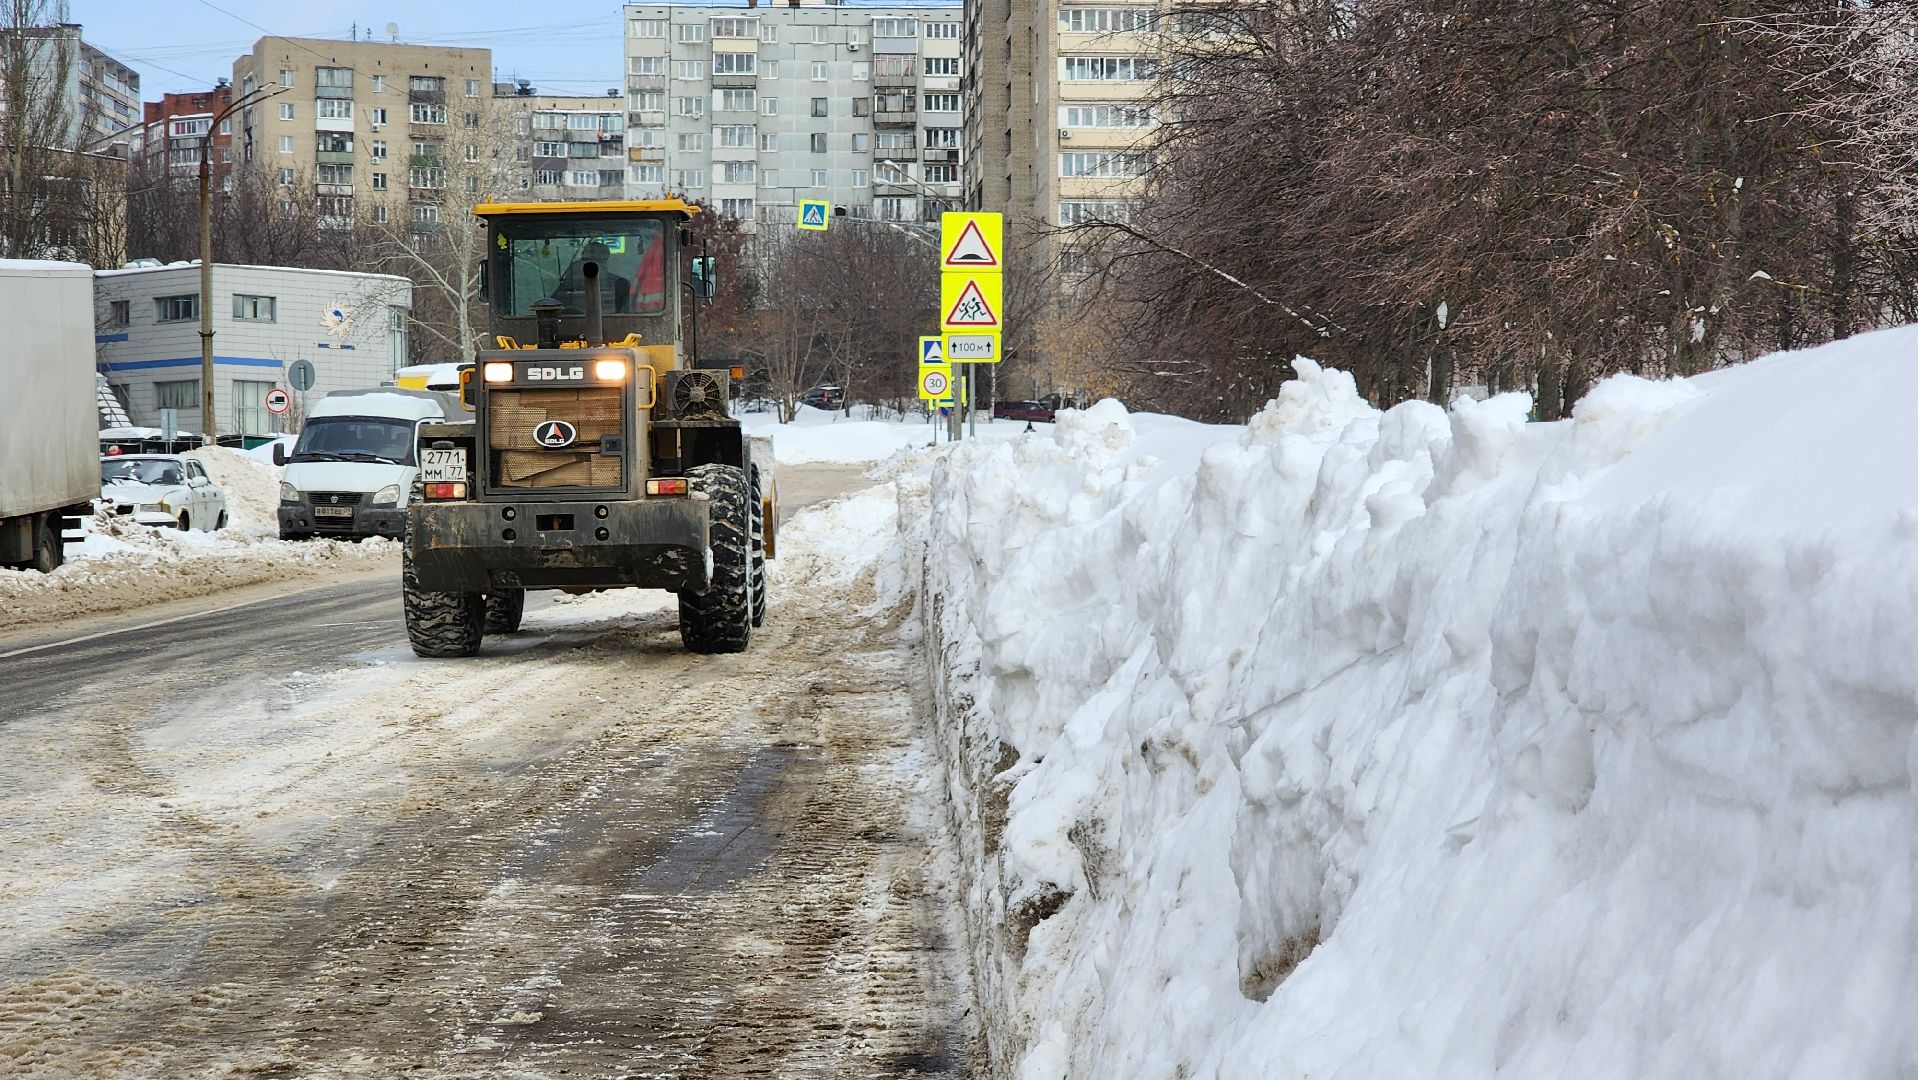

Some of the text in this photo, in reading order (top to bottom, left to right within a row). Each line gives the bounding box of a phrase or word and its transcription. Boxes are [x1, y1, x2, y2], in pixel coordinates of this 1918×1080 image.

[959, 342, 976, 352] 100
[527, 366, 584, 381] SDLG
[928, 378, 942, 388] 30
[427, 451, 461, 464] 2771
[449, 466, 463, 477] 77
